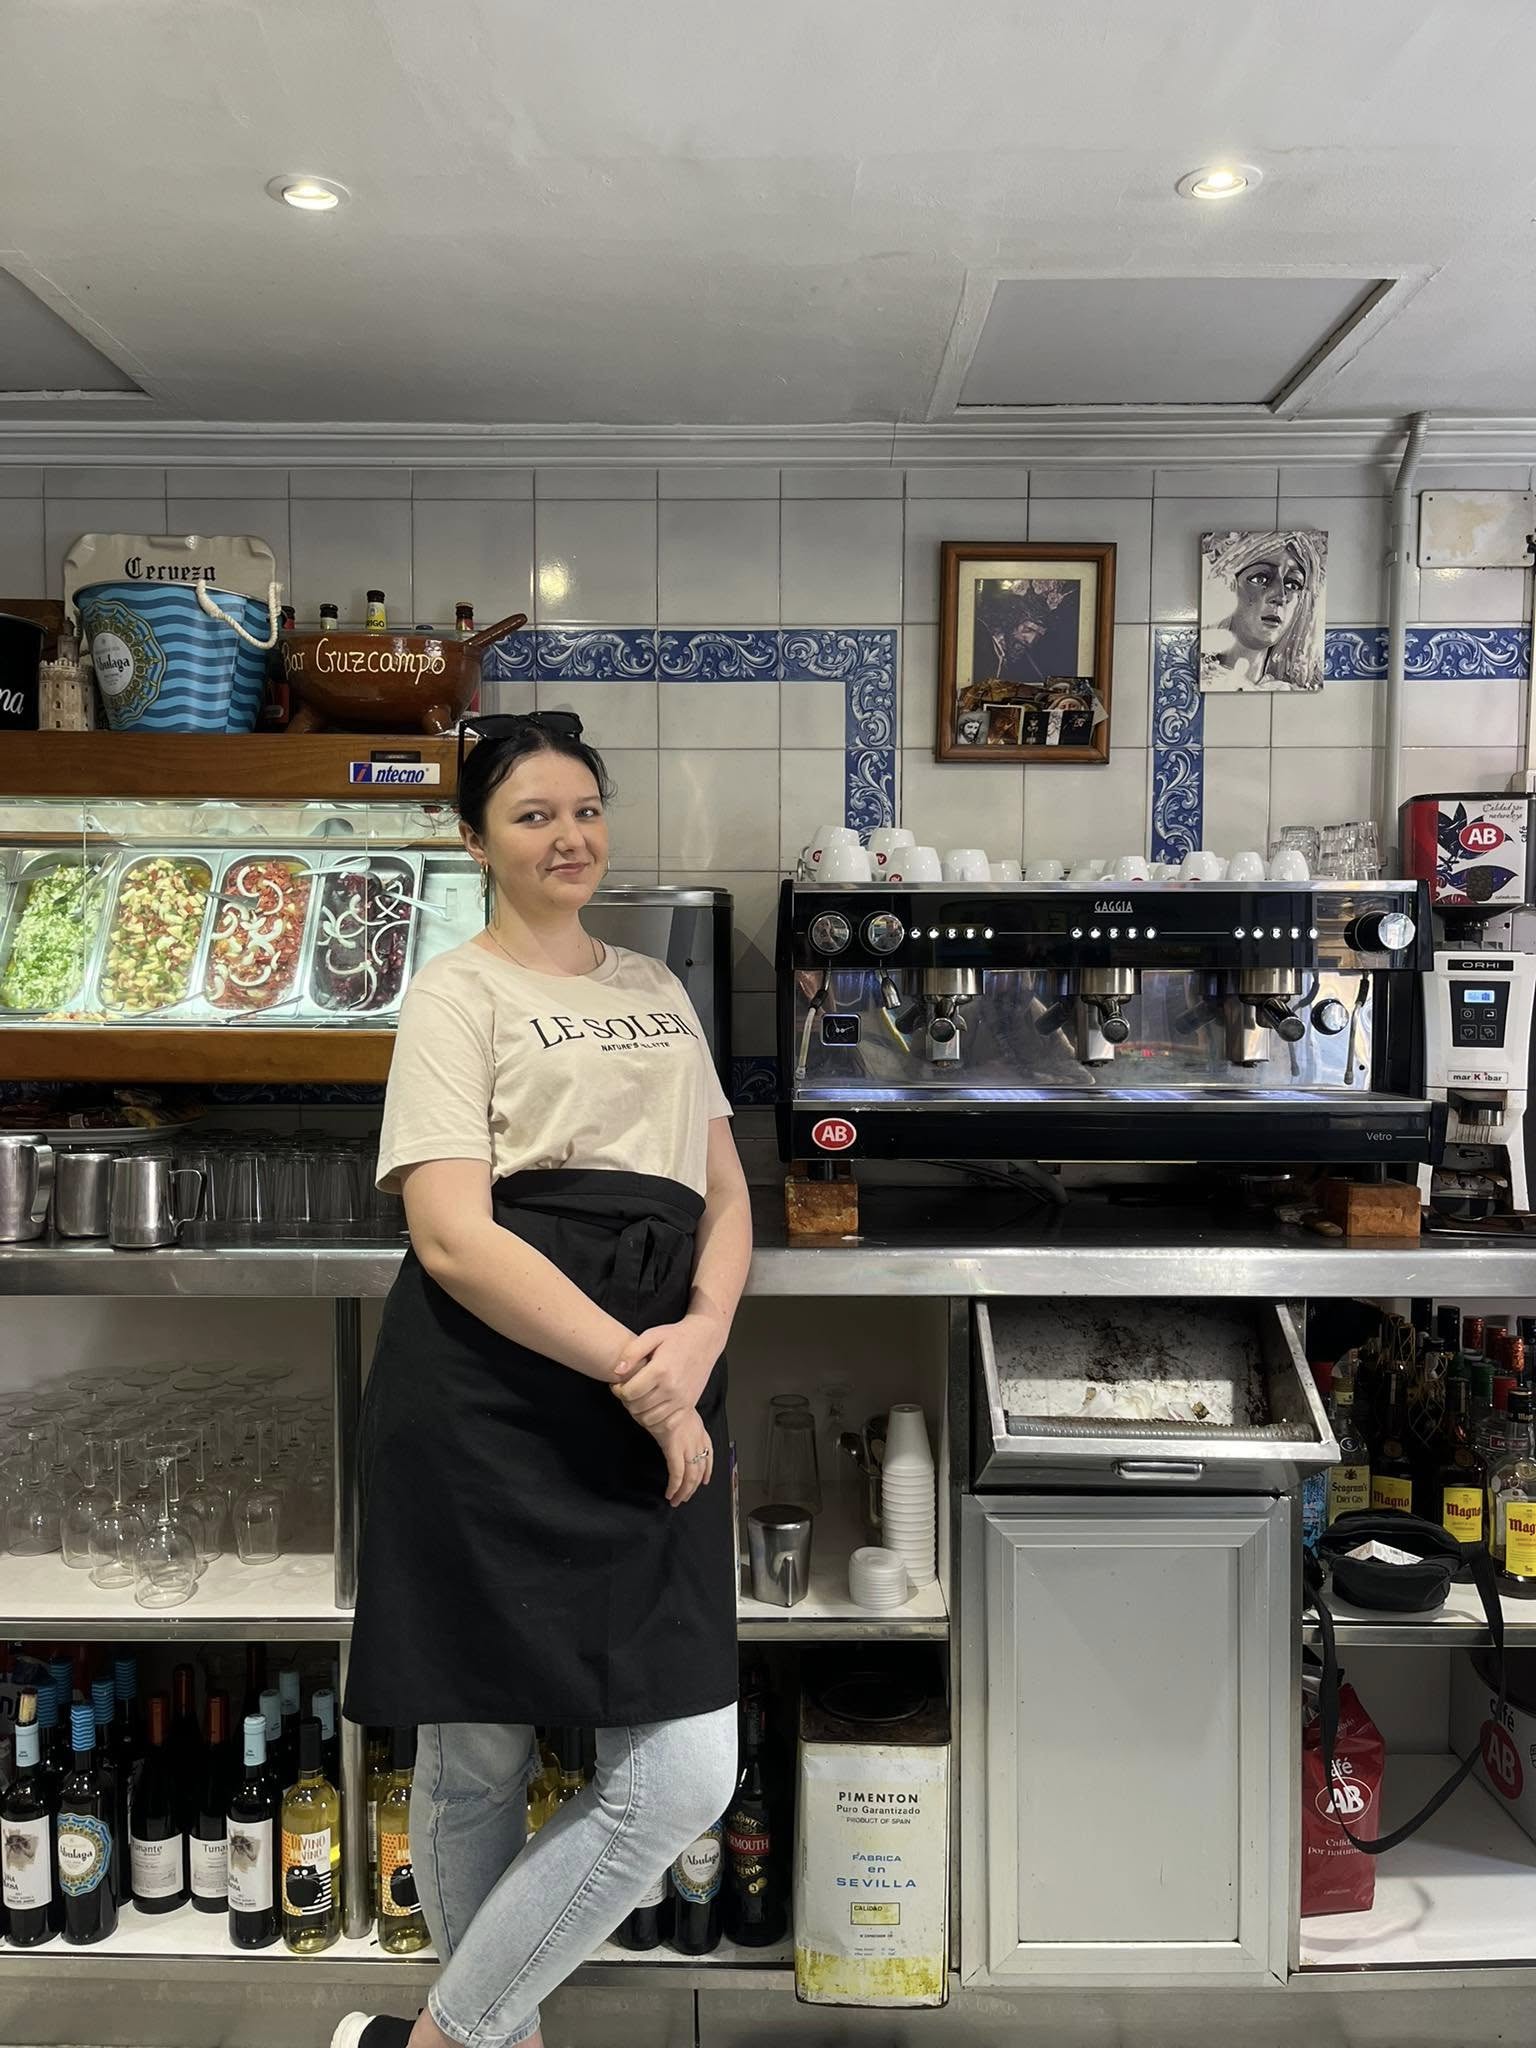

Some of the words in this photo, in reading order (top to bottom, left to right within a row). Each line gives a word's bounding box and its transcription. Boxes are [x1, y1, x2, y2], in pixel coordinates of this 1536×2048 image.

[125, 557, 216, 581] Cerveza
[282, 642, 305, 680] Bar
[316, 637, 446, 685] Cruzcampo
[1467, 828, 1497, 845] AB
[1094, 901, 1134, 913] GAGGIA
[530, 1016, 585, 1049] LE
[821, 1125, 848, 1142] AB
[1366, 1132, 1392, 1141] Vetro
[1374, 1490, 1410, 1508] Magno
[1446, 1503, 1481, 1520] Magno
[1490, 1698, 1514, 1733] cfé
[1488, 1732, 1515, 1786] AB
[839, 1792, 918, 1803] PIMENTON
[1326, 1785, 1365, 1814] AB
[836, 1804, 858, 1813] Puro
[862, 1805, 920, 1815] Garantizado
[729, 1835, 769, 1851] RMOUTH
[836, 1878, 916, 1888] SEVILLA
